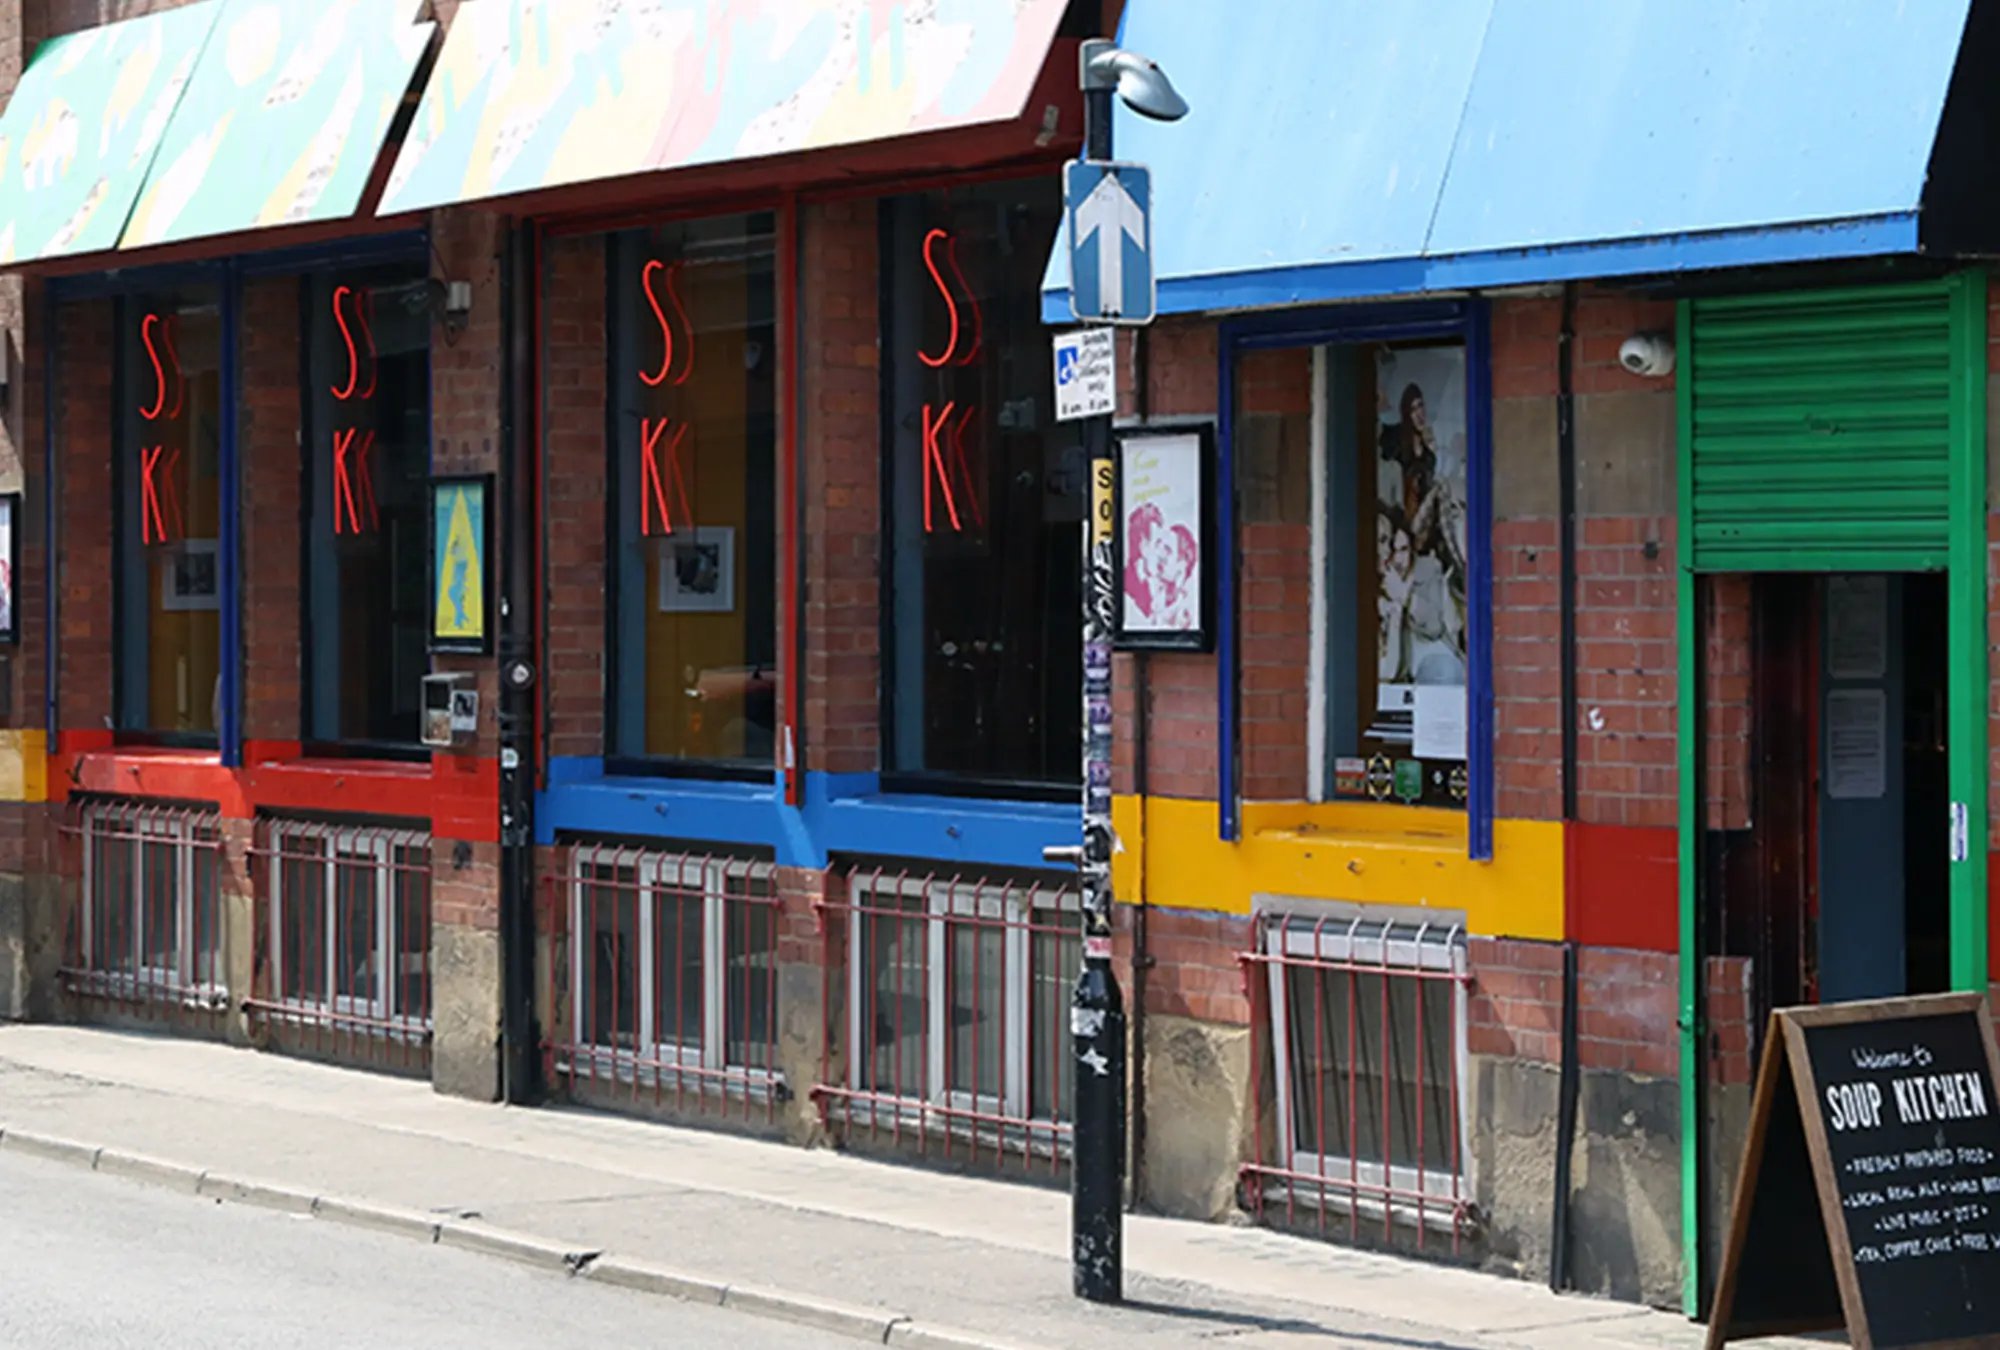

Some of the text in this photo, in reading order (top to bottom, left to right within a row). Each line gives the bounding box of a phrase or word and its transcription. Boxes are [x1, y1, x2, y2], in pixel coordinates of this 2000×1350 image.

[330, 286, 358, 399] S
[639, 259, 673, 386] S
[919, 227, 959, 366] S
[139, 313, 165, 419] S
[141, 445, 167, 545] K
[333, 427, 360, 535] K
[641, 417, 673, 536] K
[922, 401, 961, 532] K
[1825, 1071, 1988, 1131] SOUP KITCHEN
